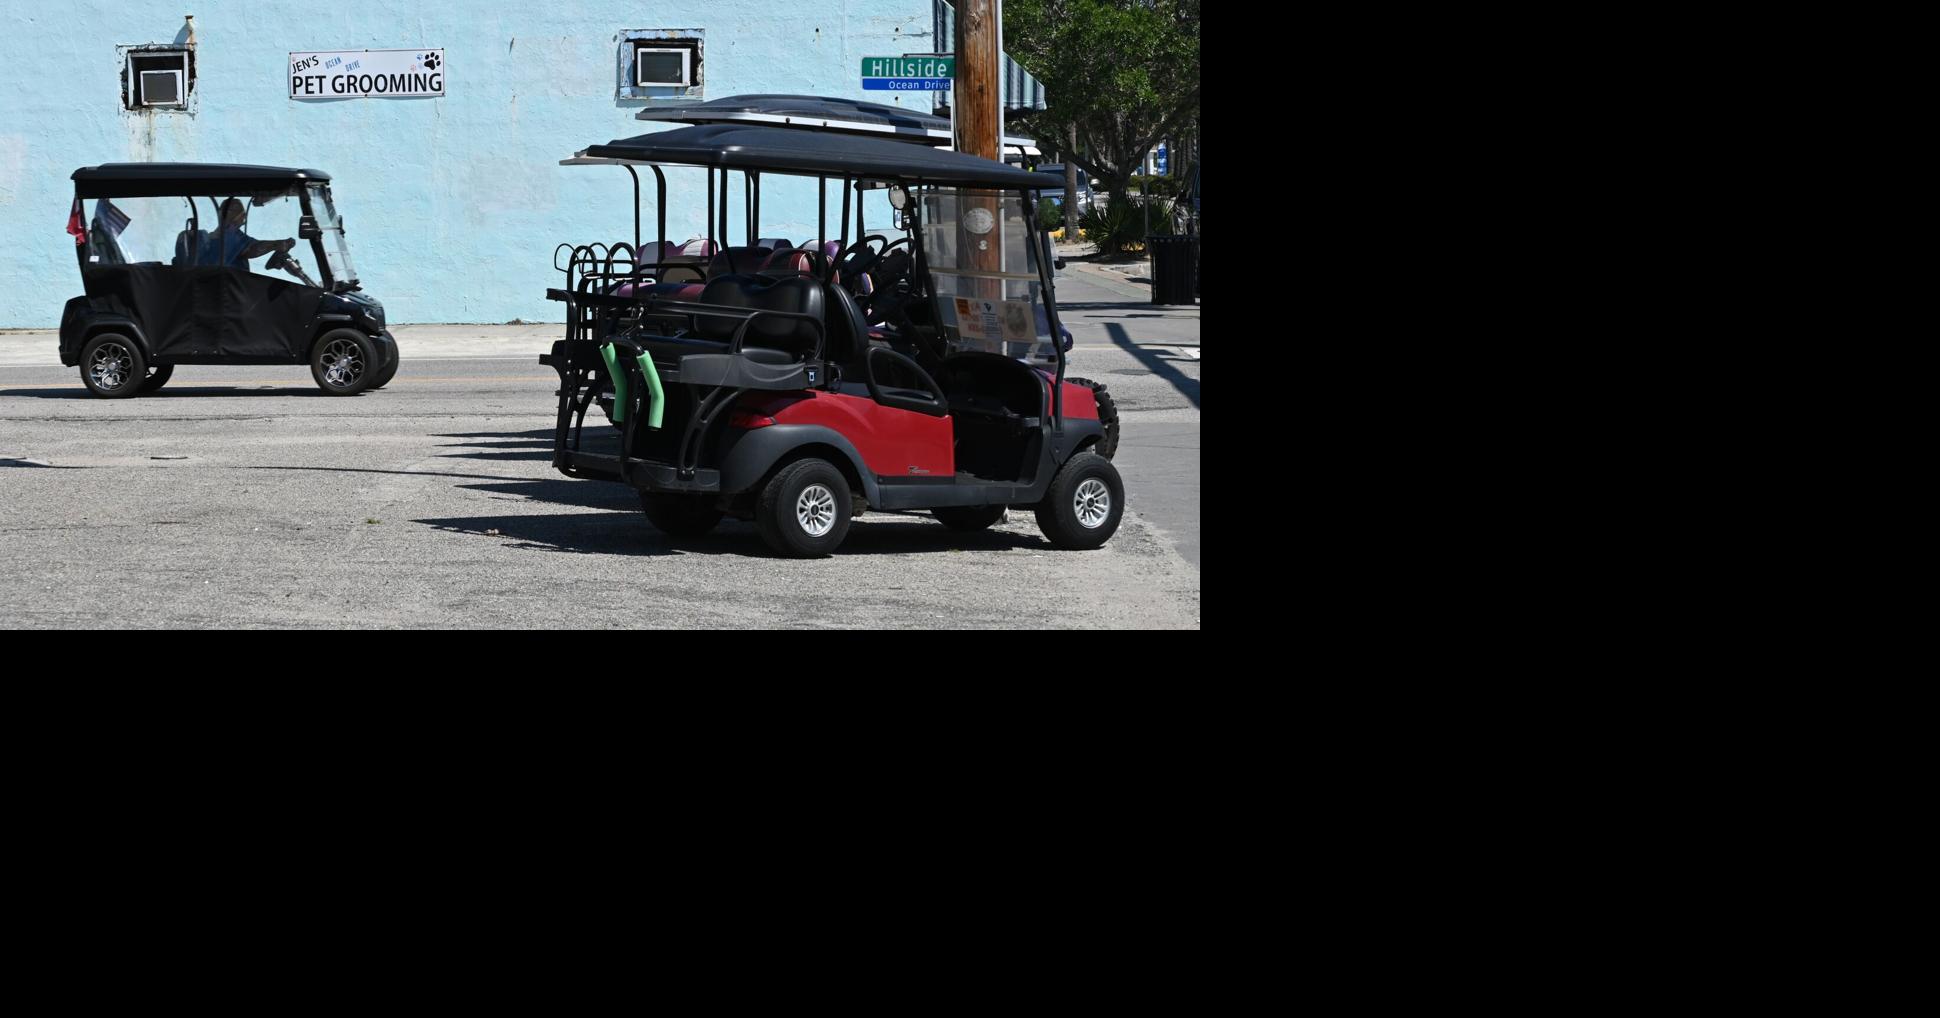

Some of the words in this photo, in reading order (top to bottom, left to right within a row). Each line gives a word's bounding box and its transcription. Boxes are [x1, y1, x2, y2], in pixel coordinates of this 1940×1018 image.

[292, 55, 319, 74] JEN'S
[325, 56, 342, 69] OCEAN
[345, 60, 360, 72] DRIVE
[872, 59, 947, 77] Hillside
[292, 75, 326, 95] PET
[331, 73, 442, 94] GROOMING
[888, 81, 920, 89] Ocean
[925, 81, 950, 89] Drive
